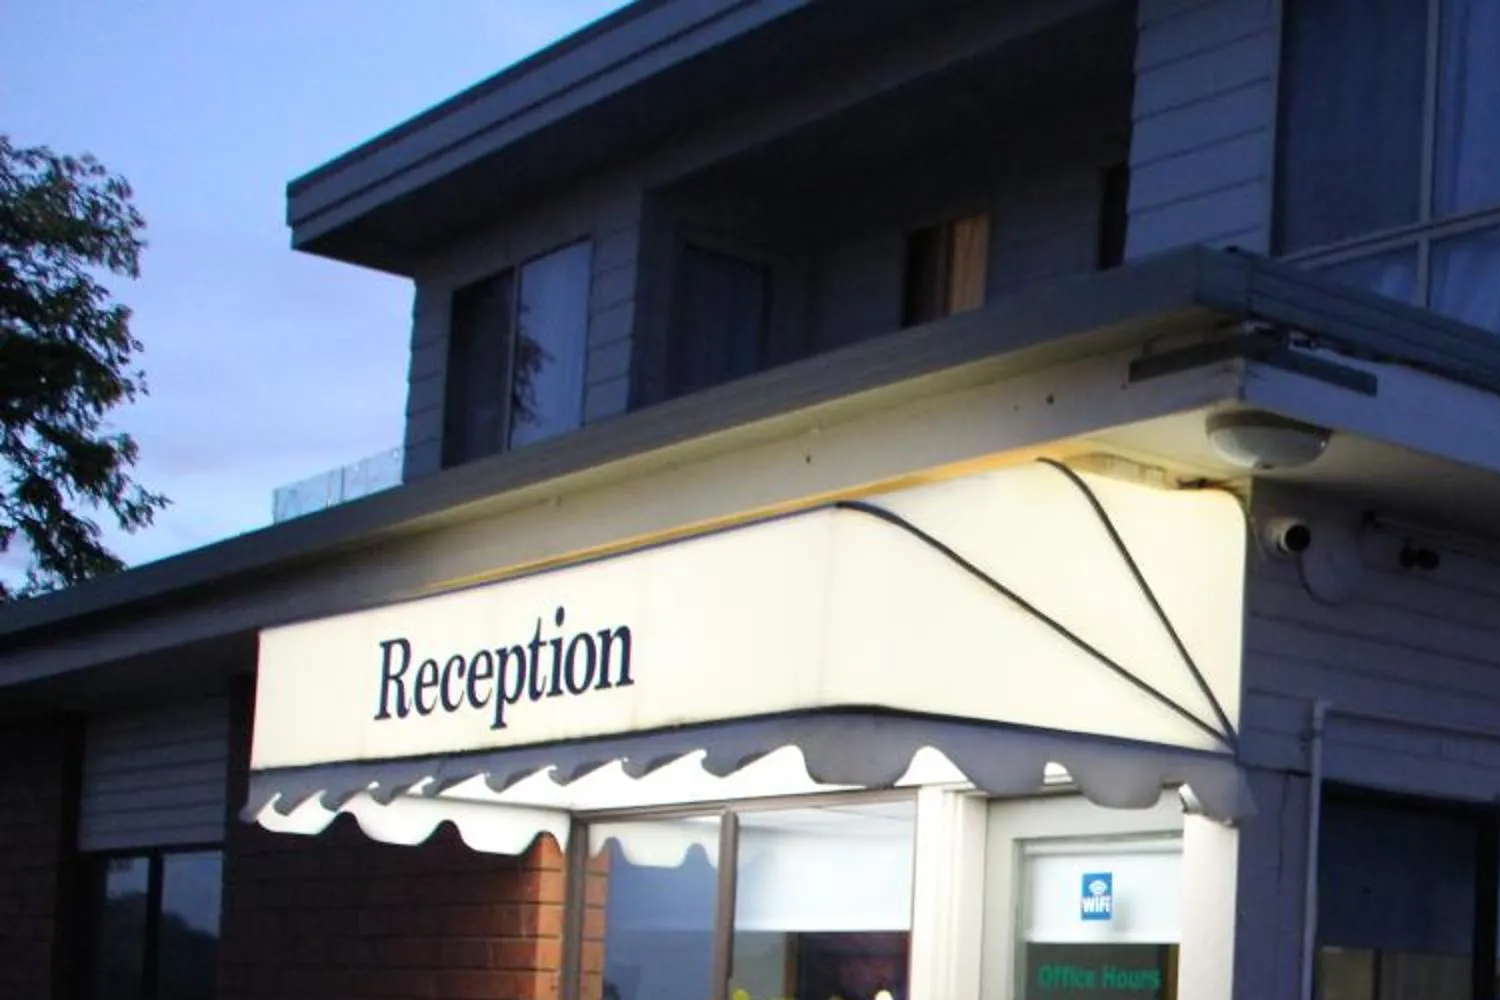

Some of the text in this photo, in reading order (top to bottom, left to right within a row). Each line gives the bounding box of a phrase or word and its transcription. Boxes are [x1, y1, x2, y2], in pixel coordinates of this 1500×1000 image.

[374, 605, 635, 731] Reception
[1038, 965, 1161, 990] Office Hours
